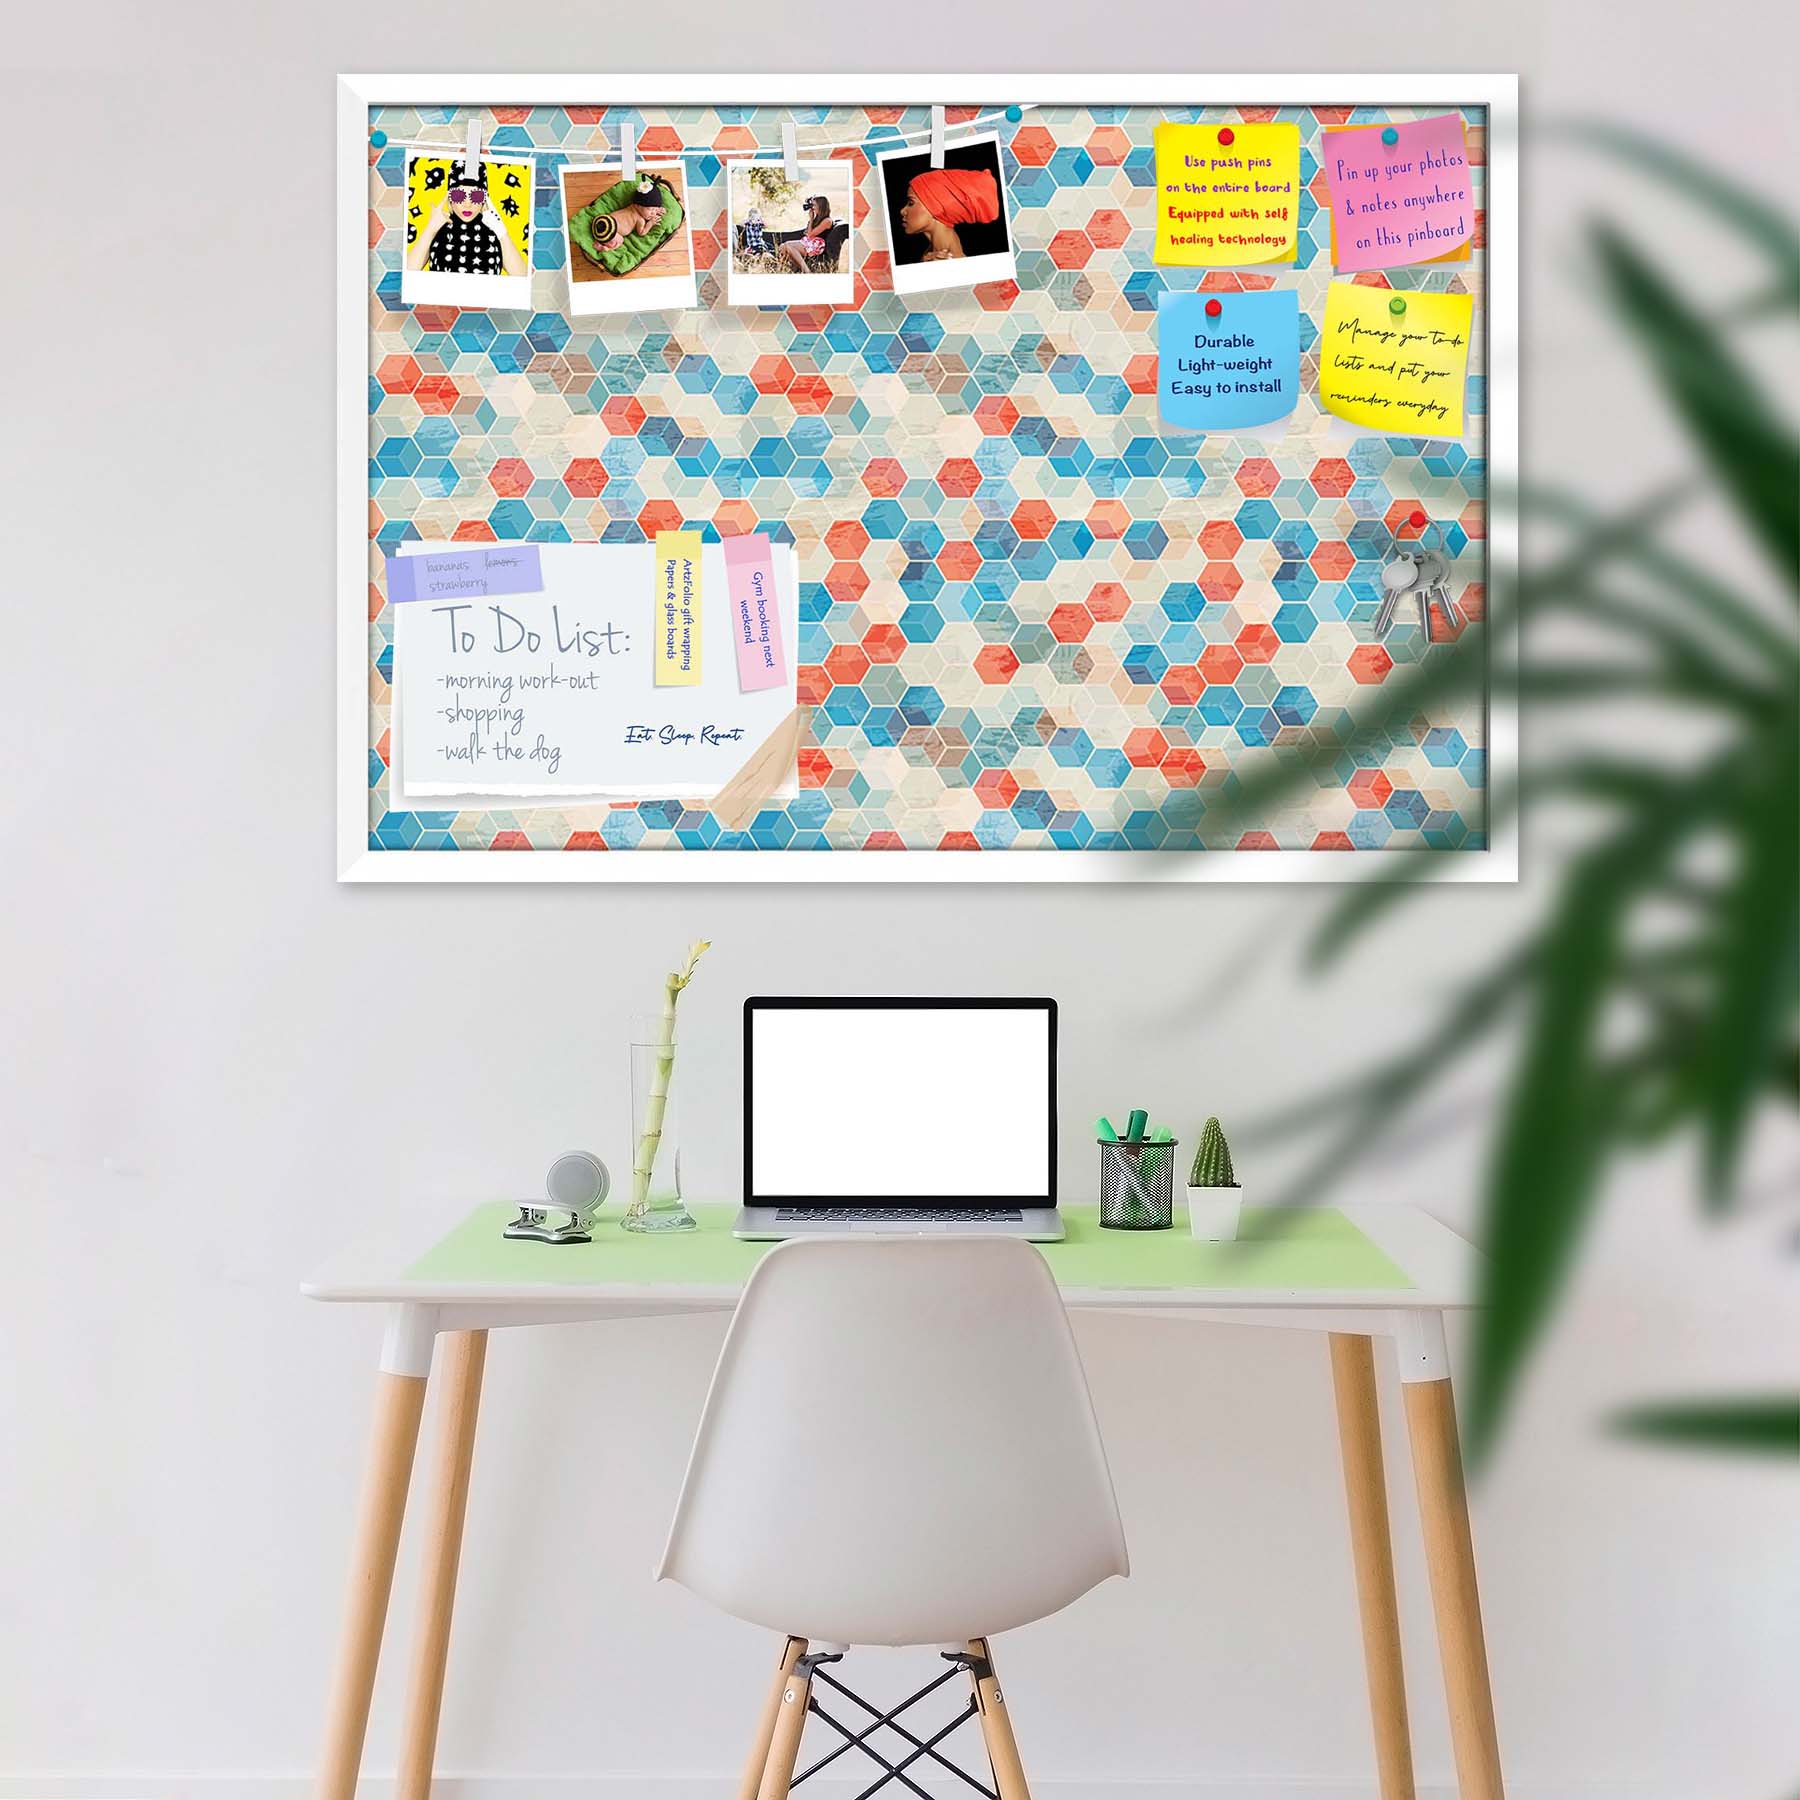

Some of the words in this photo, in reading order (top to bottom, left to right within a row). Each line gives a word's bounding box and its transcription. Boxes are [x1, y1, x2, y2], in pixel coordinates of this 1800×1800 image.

[1184, 154, 1206, 168] Use
[1211, 157, 1243, 172] push
[1247, 157, 1272, 172] pins
[1337, 159, 1359, 182] Pin
[1364, 167, 1379, 182] up
[1385, 162, 1413, 181] your
[1419, 148, 1463, 176] photos
[1166, 184, 1180, 193] on
[1184, 182, 1207, 194] the
[1212, 182, 1250, 193] entire
[1255, 180, 1291, 193] board
[1346, 199, 1355, 216] &
[1361, 192, 1397, 214] notes
[1403, 184, 1465, 211] anywhere
[1168, 206, 1225, 223] Equipped
[1229, 208, 1259, 220] with
[1264, 207, 1289, 221] self
[1170, 234, 1214, 247] healing
[1218, 233, 1287, 247] technology
[1356, 238, 1371, 249] on
[1376, 226, 1402, 246] this
[1407, 215, 1465, 248] pinboard
[1194, 334, 1255, 349] Durable
[1337, 317, 1397, 344] Manage
[1398, 330, 1428, 347] your
[1178, 356, 1273, 375] Light-weight
[1334, 354, 1365, 370] lists
[1368, 360, 1396, 374] and
[1397, 361, 1425, 381] put
[1421, 369, 1451, 383] your
[1171, 381, 1212, 398] Easy
[1216, 382, 1231, 394] to
[1235, 378, 1282, 393] install
[1330, 392, 1392, 408] reminders
[1396, 399, 1449, 420] everyday
[426, 559, 470, 573] bananas
[664, 559, 677, 590] Papers
[428, 574, 489, 596] strawberry
[667, 591, 676, 600] &
[683, 558, 694, 606] ArtzFolio
[751, 571, 764, 597] Gym
[664, 602, 678, 625] glass
[680, 607, 695, 626] gift
[740, 599, 756, 644] weekend
[757, 599, 771, 642] booking
[431, 604, 475, 653] To
[488, 605, 541, 653] Do
[553, 604, 630, 657] List:
[666, 627, 678, 660] boards
[680, 627, 694, 671] wrapping
[763, 645, 776, 668] next
[519, 662, 600, 690] work-out
[492, 731, 525, 761] the
[529, 733, 562, 775] dog
